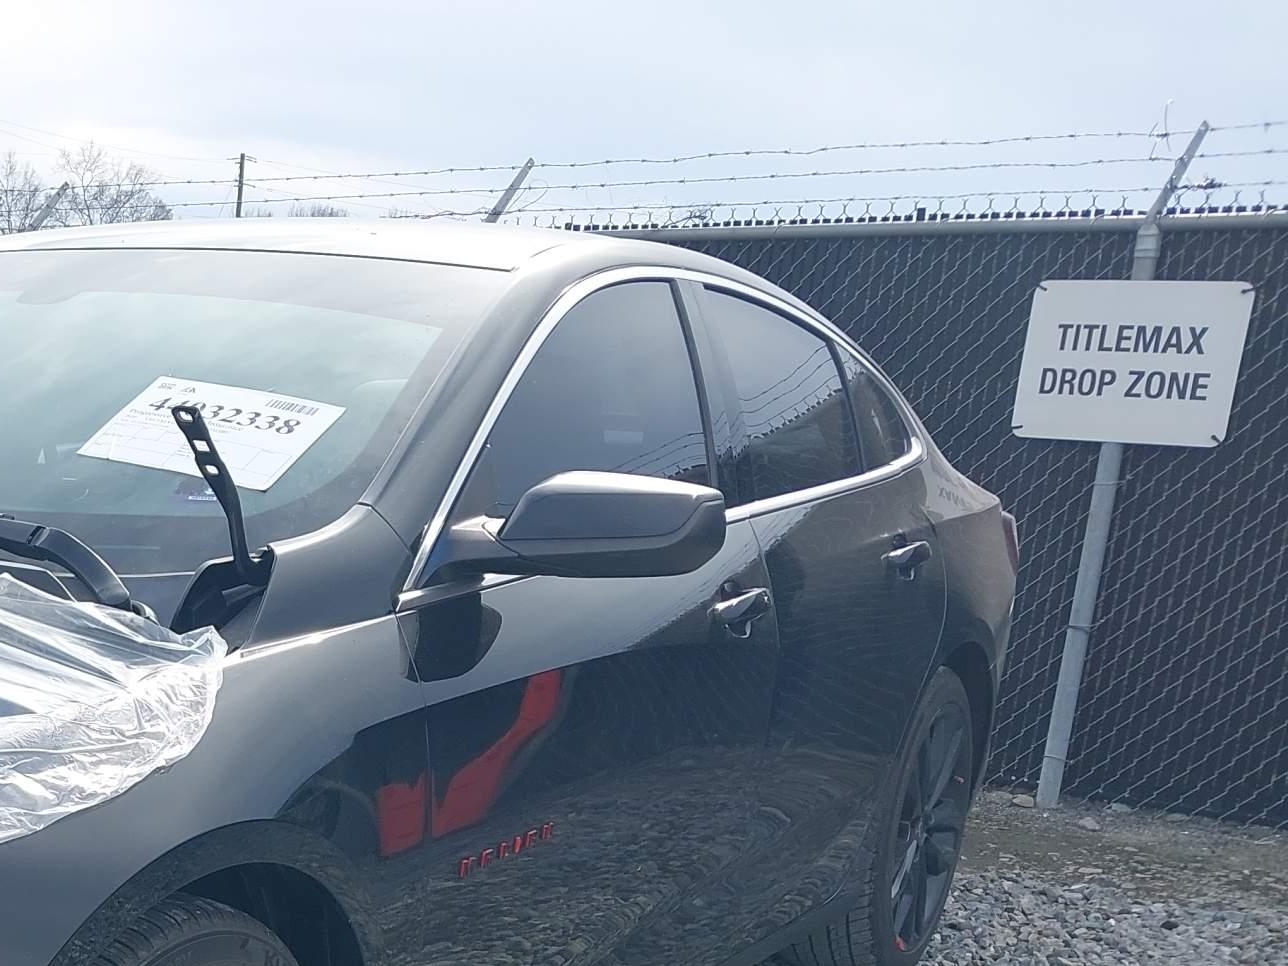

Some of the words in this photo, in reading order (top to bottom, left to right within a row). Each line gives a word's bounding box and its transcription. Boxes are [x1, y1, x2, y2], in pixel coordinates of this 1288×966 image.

[1058, 323, 1210, 355] TITLEMAX
[1038, 367, 1117, 396] DROP
[1123, 370, 1211, 401] ZONE
